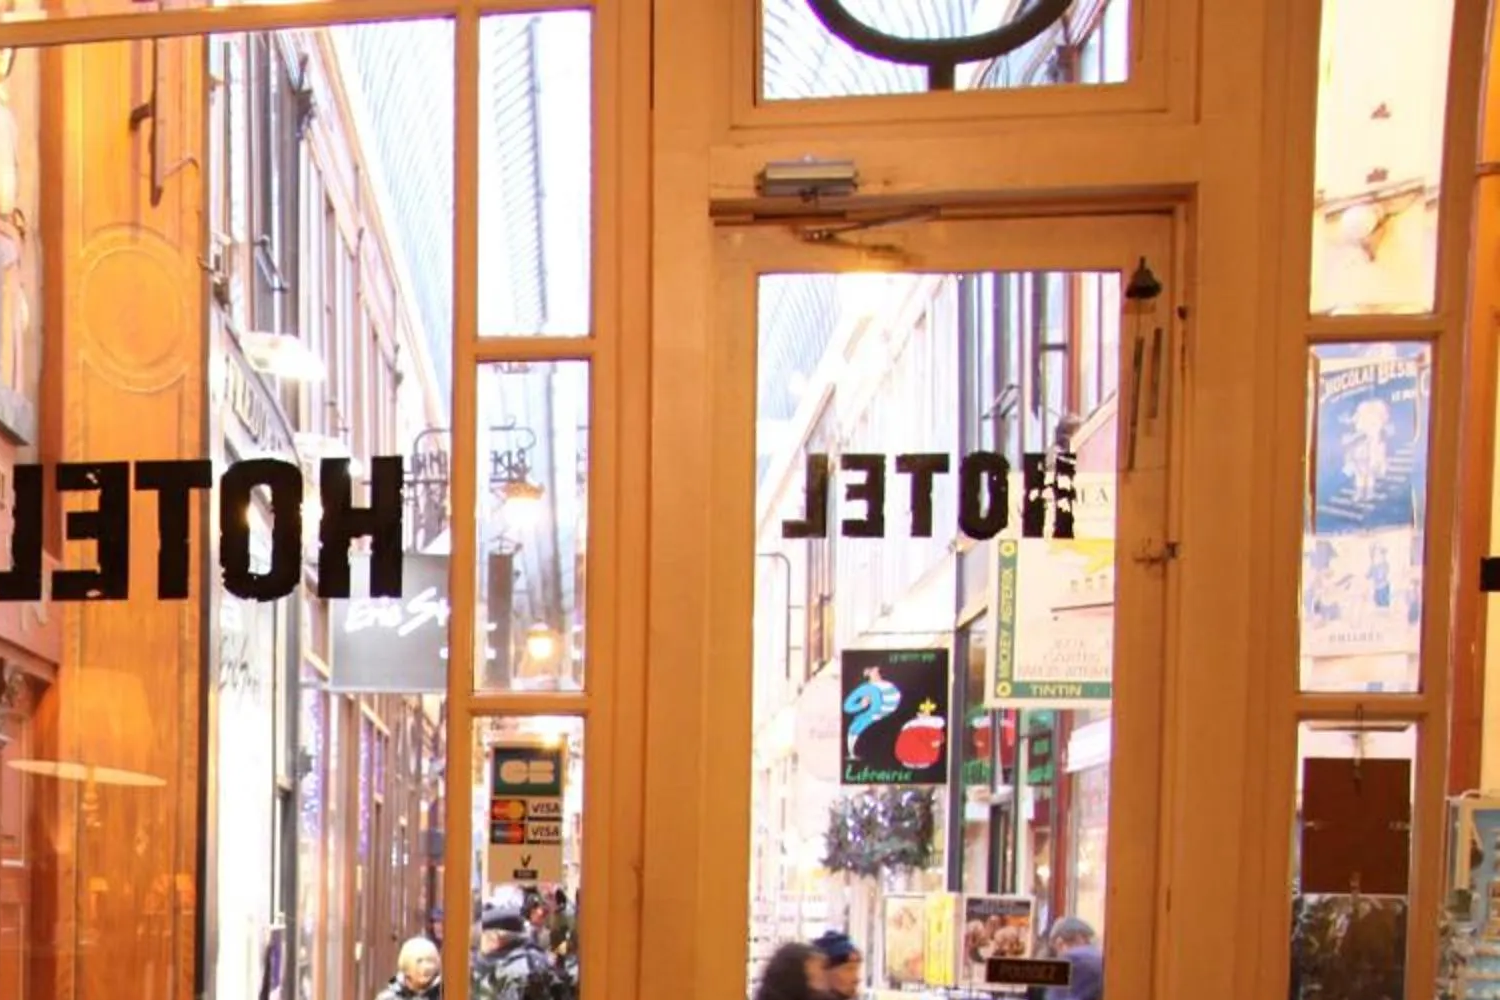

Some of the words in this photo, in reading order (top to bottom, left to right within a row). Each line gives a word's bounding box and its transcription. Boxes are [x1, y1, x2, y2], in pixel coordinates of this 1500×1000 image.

[1029, 683, 1083, 697] TINTIN
[531, 803, 560, 813] VISA
[531, 826, 560, 837] VISA
